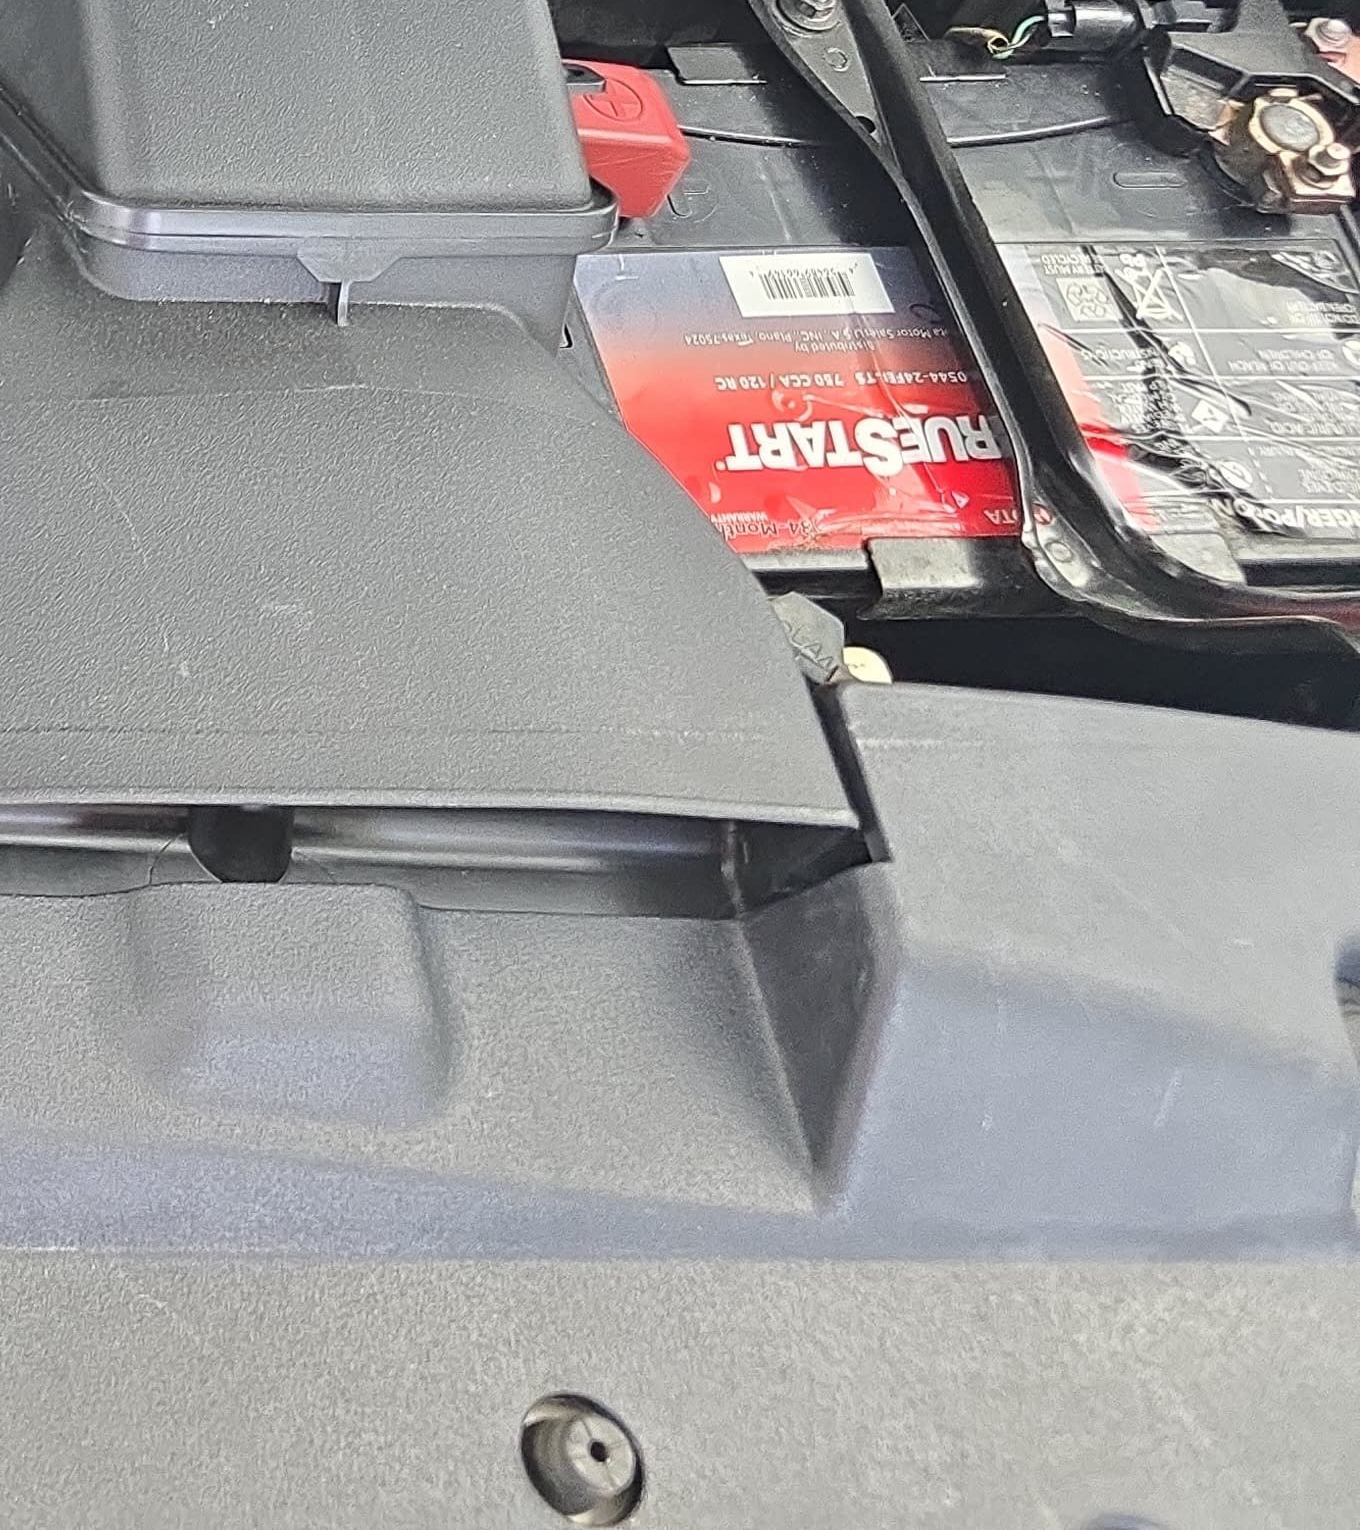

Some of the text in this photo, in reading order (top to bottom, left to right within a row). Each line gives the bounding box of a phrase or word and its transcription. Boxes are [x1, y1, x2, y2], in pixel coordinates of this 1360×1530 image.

[895, 328, 931, 340] Motor
[714, 376, 739, 391] RC
[739, 375, 767, 390] 120
[778, 374, 812, 388] CCA
